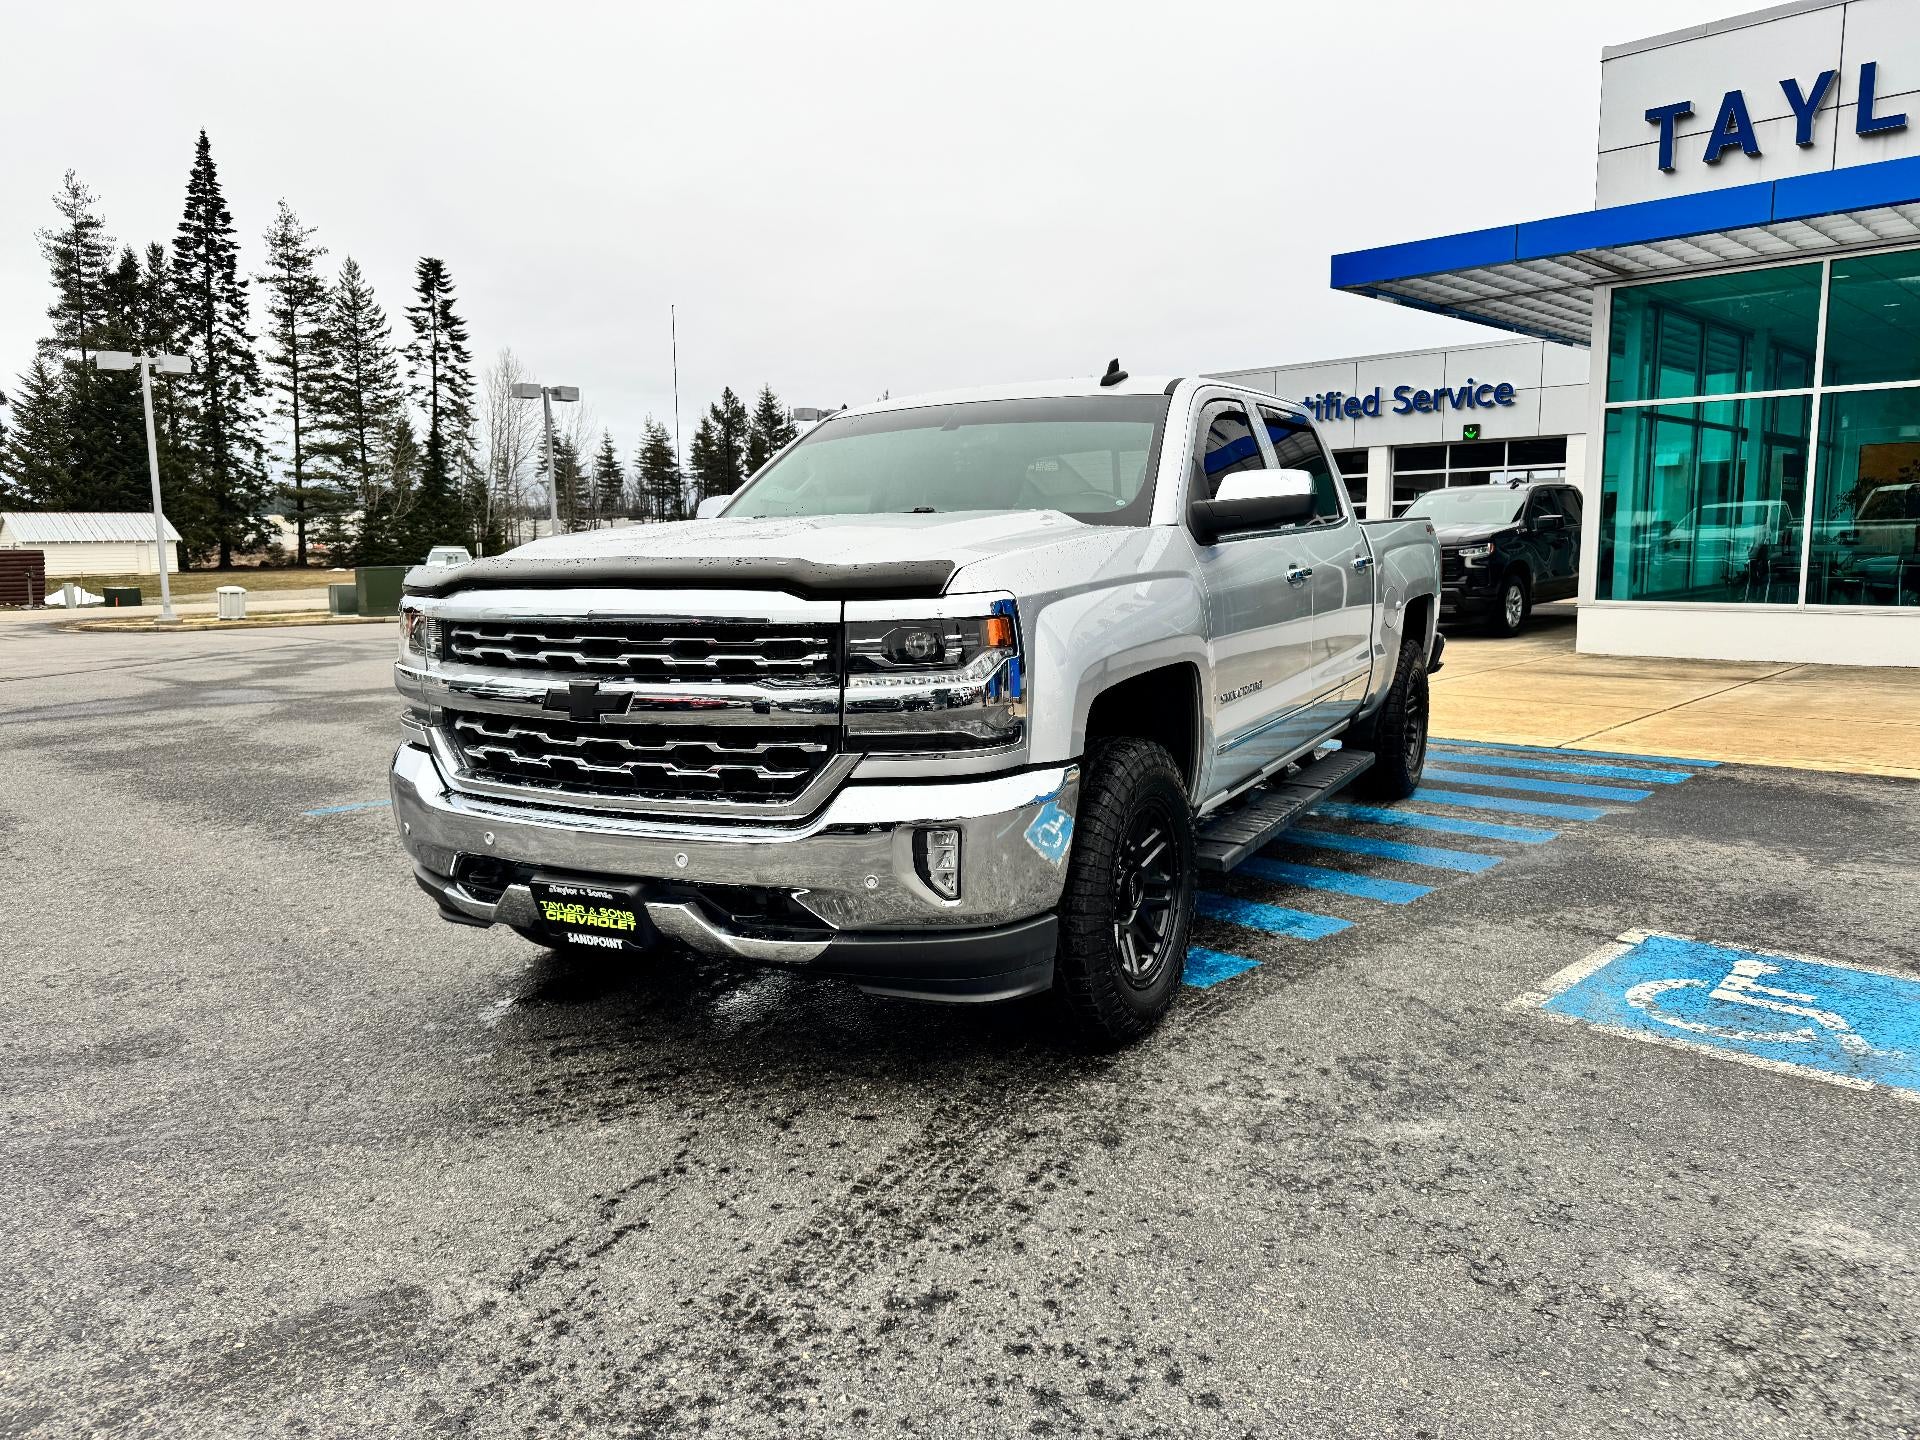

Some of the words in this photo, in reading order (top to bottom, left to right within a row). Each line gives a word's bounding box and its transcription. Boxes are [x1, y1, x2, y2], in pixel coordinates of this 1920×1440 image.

[1645, 61, 1909, 172] TAYL
[1392, 378, 1515, 415] Service
[551, 885, 577, 896] Taylor
[587, 889, 610, 899] Sons
[540, 900, 586, 914] TAYLOR
[589, 907, 597, 917] &
[599, 907, 635, 921] SONS
[546, 911, 637, 932] CHEVROLET
[567, 932, 623, 950] SANDPOINT
